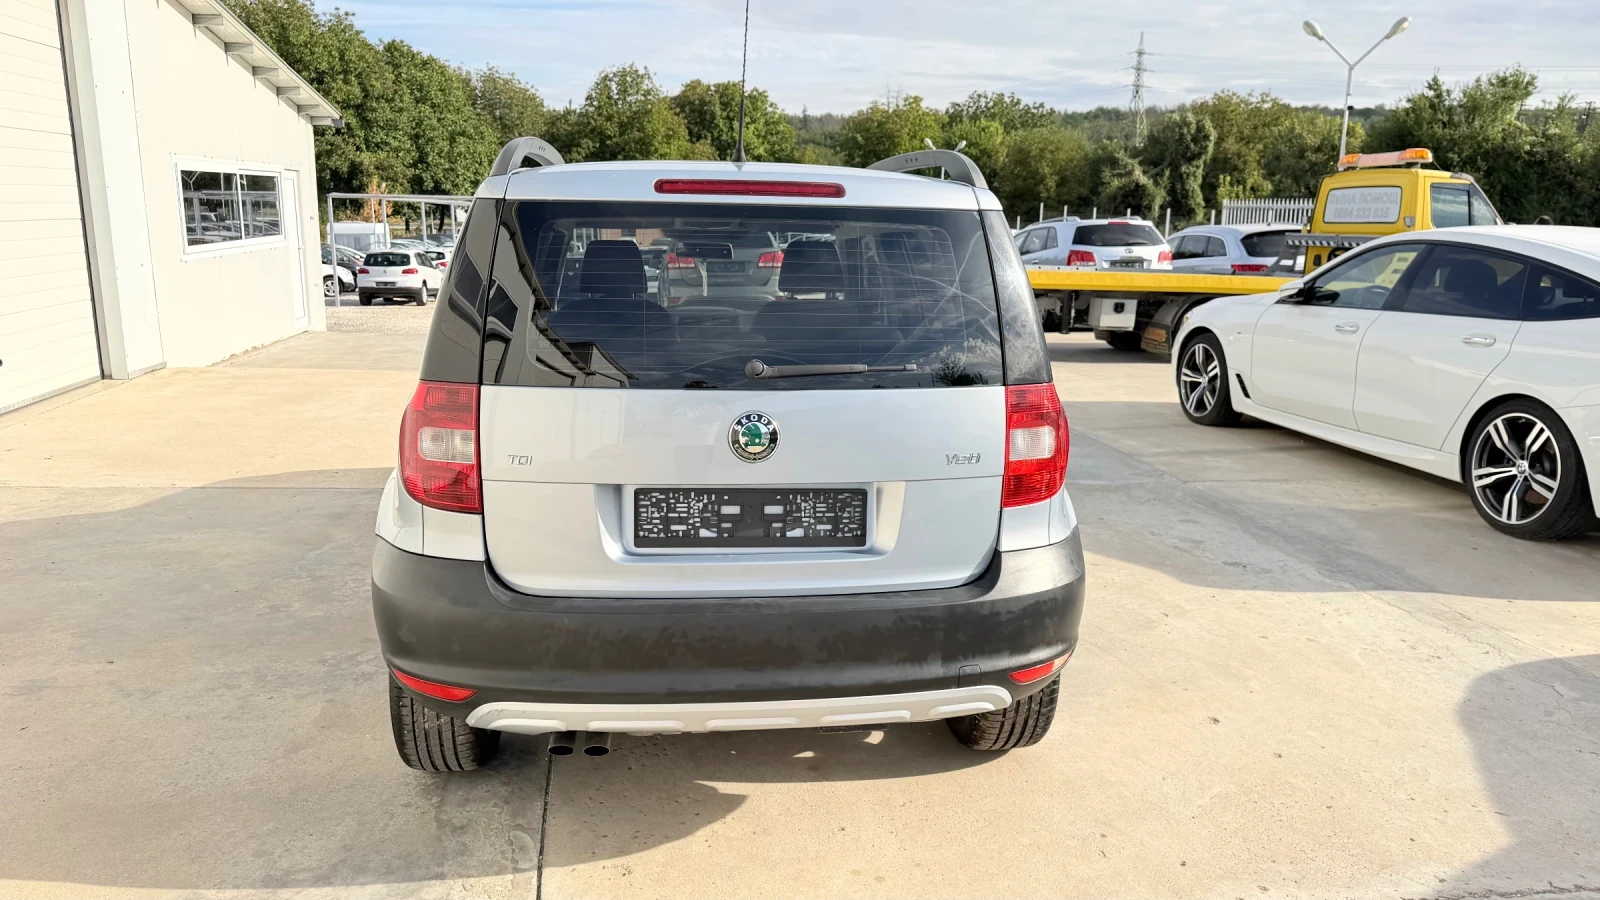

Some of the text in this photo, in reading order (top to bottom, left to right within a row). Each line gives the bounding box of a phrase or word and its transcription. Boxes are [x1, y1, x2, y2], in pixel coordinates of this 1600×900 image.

[1358, 191, 1399, 206] ПОМОЩ
[508, 454, 533, 466] TDI
[945, 452, 981, 466] Yeti
